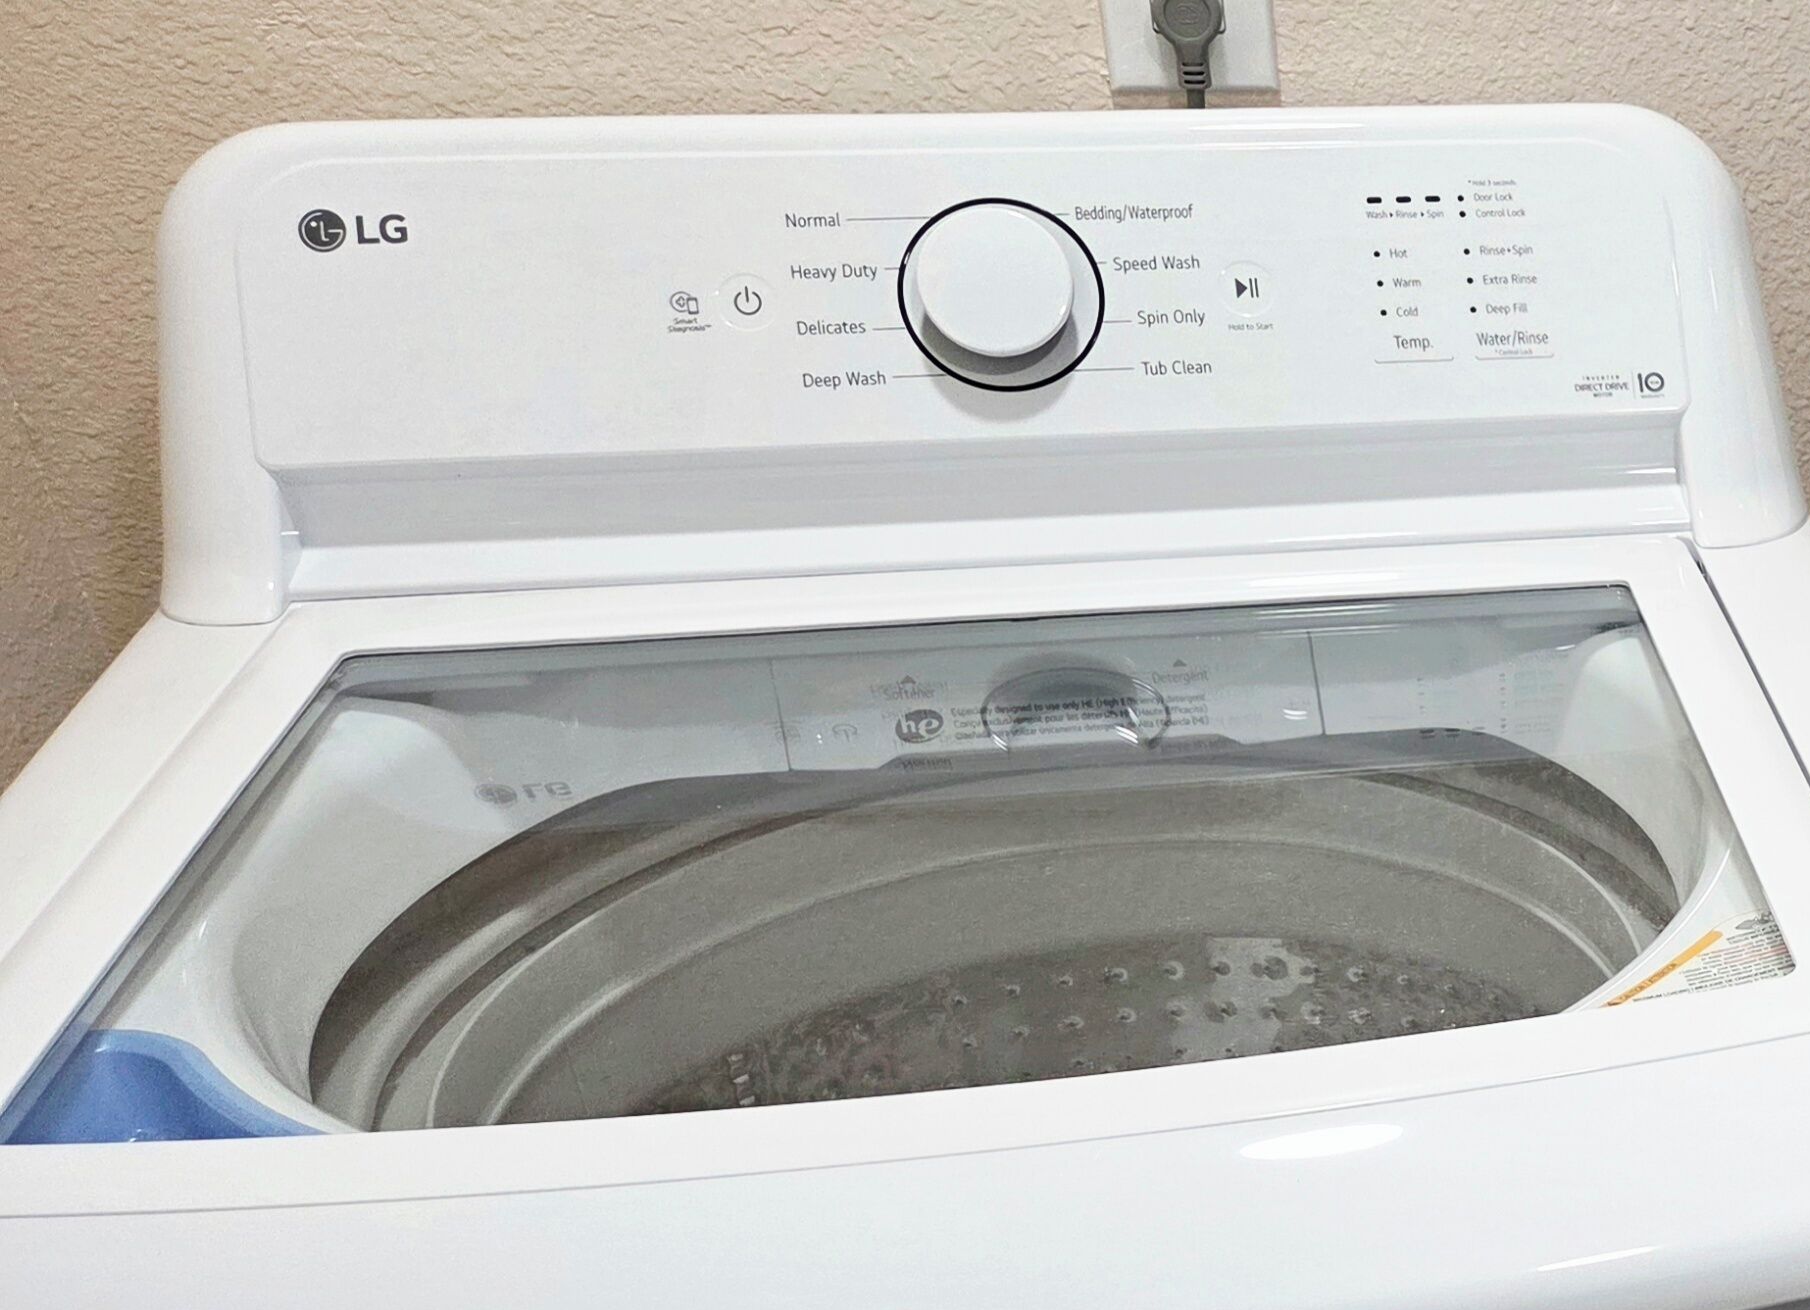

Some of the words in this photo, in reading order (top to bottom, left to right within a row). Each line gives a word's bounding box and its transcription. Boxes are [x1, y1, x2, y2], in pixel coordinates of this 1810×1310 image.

[1473, 193, 1492, 202] Door
[1494, 192, 1513, 201] Lock
[784, 211, 841, 228] Normal
[1074, 203, 1193, 223] Bedding/Waterproof
[1365, 210, 1388, 219] Wash
[1395, 210, 1418, 219] Rinse
[1426, 209, 1445, 219] Spin
[1475, 209, 1505, 218] Control
[1507, 208, 1526, 217] Lock
[356, 213, 408, 245] LG
[1389, 247, 1408, 259] Hot
[1112, 256, 1158, 274] Speed
[1161, 254, 1200, 270] Wash
[790, 264, 837, 283] Heavy
[841, 263, 878, 282] Duty
[1482, 274, 1509, 286] Extra
[1511, 273, 1538, 285] Rinse
[1392, 277, 1422, 289] Warm
[1395, 306, 1419, 318] Cold
[1485, 303, 1511, 316] Deep
[1512, 302, 1528, 314] Fill
[1137, 309, 1169, 328] Spin
[1173, 308, 1206, 327] Only
[1227, 323, 1245, 331] Hold
[1246, 323, 1255, 331] to
[1255, 322, 1274, 331] Start
[796, 319, 867, 336] Delicates
[1393, 334, 1434, 352] Temp.
[1476, 330, 1549, 348] Water/Rinse
[1140, 360, 1168, 376] Tub
[1172, 359, 1213, 375] Clean
[802, 372, 842, 390] Deep
[845, 370, 887, 386] Wash
[1574, 383, 1603, 392] DIRECT
[1604, 382, 1630, 391] DRIVE
